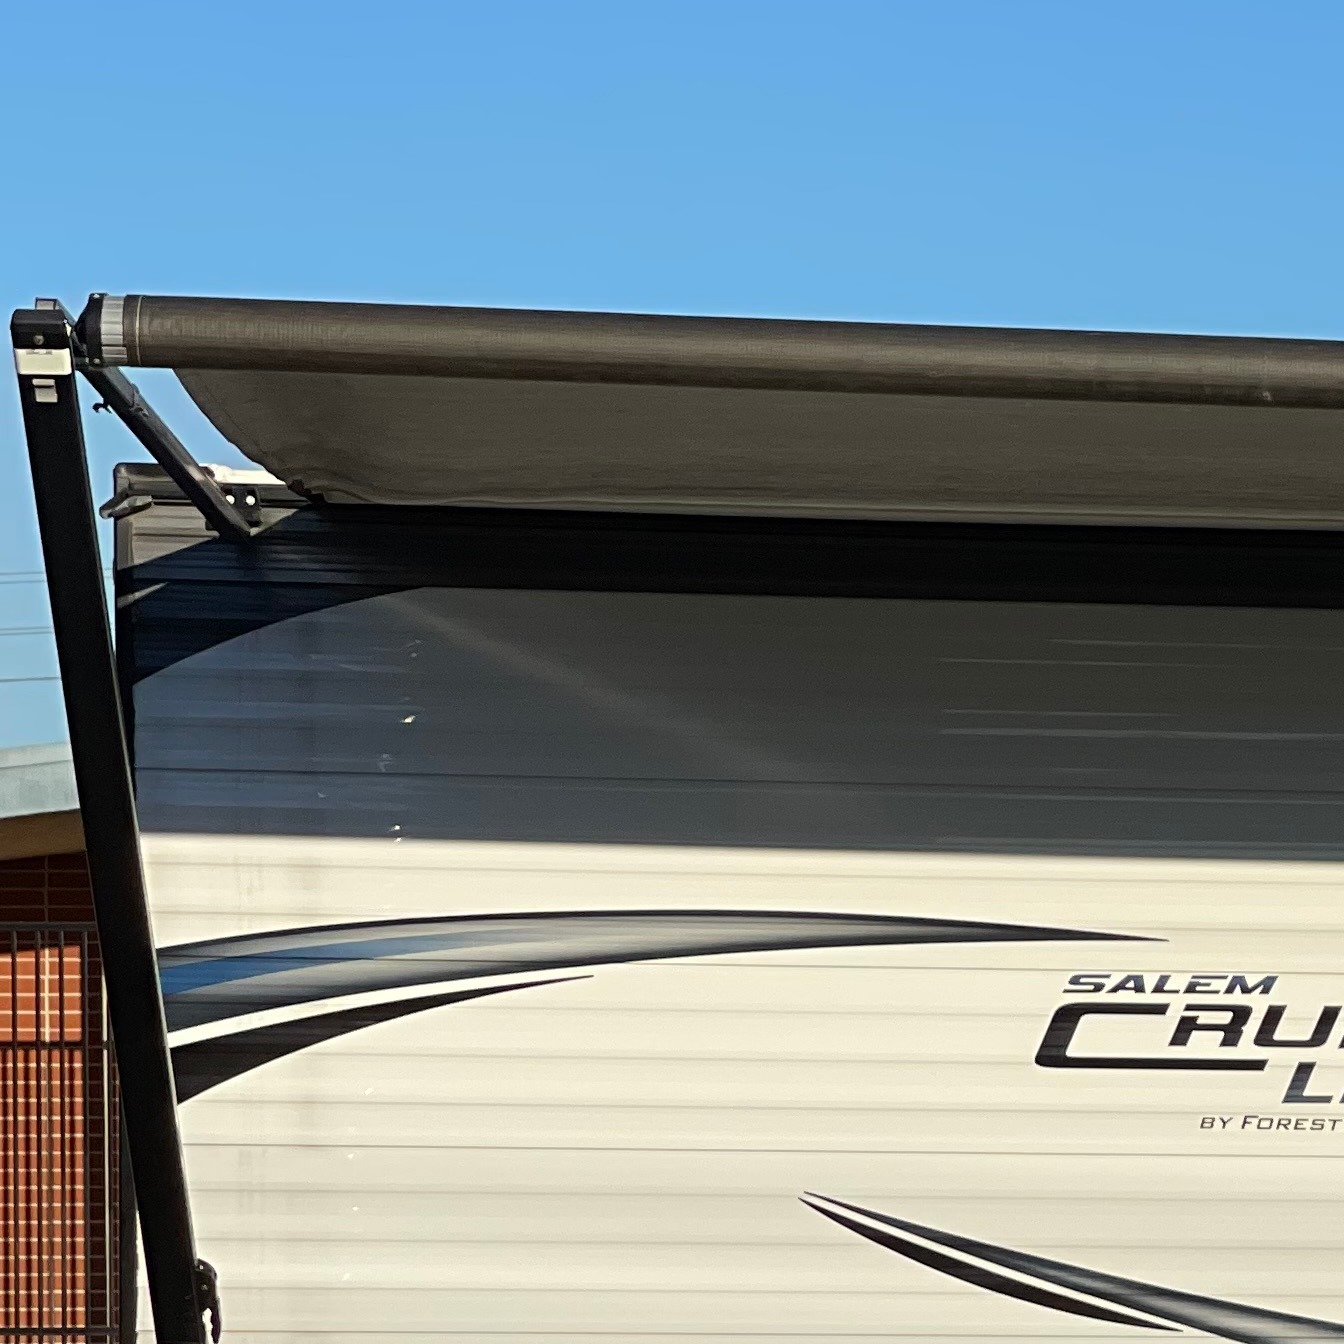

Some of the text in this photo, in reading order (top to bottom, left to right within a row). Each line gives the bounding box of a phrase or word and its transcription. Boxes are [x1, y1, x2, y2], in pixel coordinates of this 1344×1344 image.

[1063, 974, 1279, 994] SALEM
[1200, 1116, 1233, 1130] BY
[1241, 1115, 1342, 1132] FOREST
